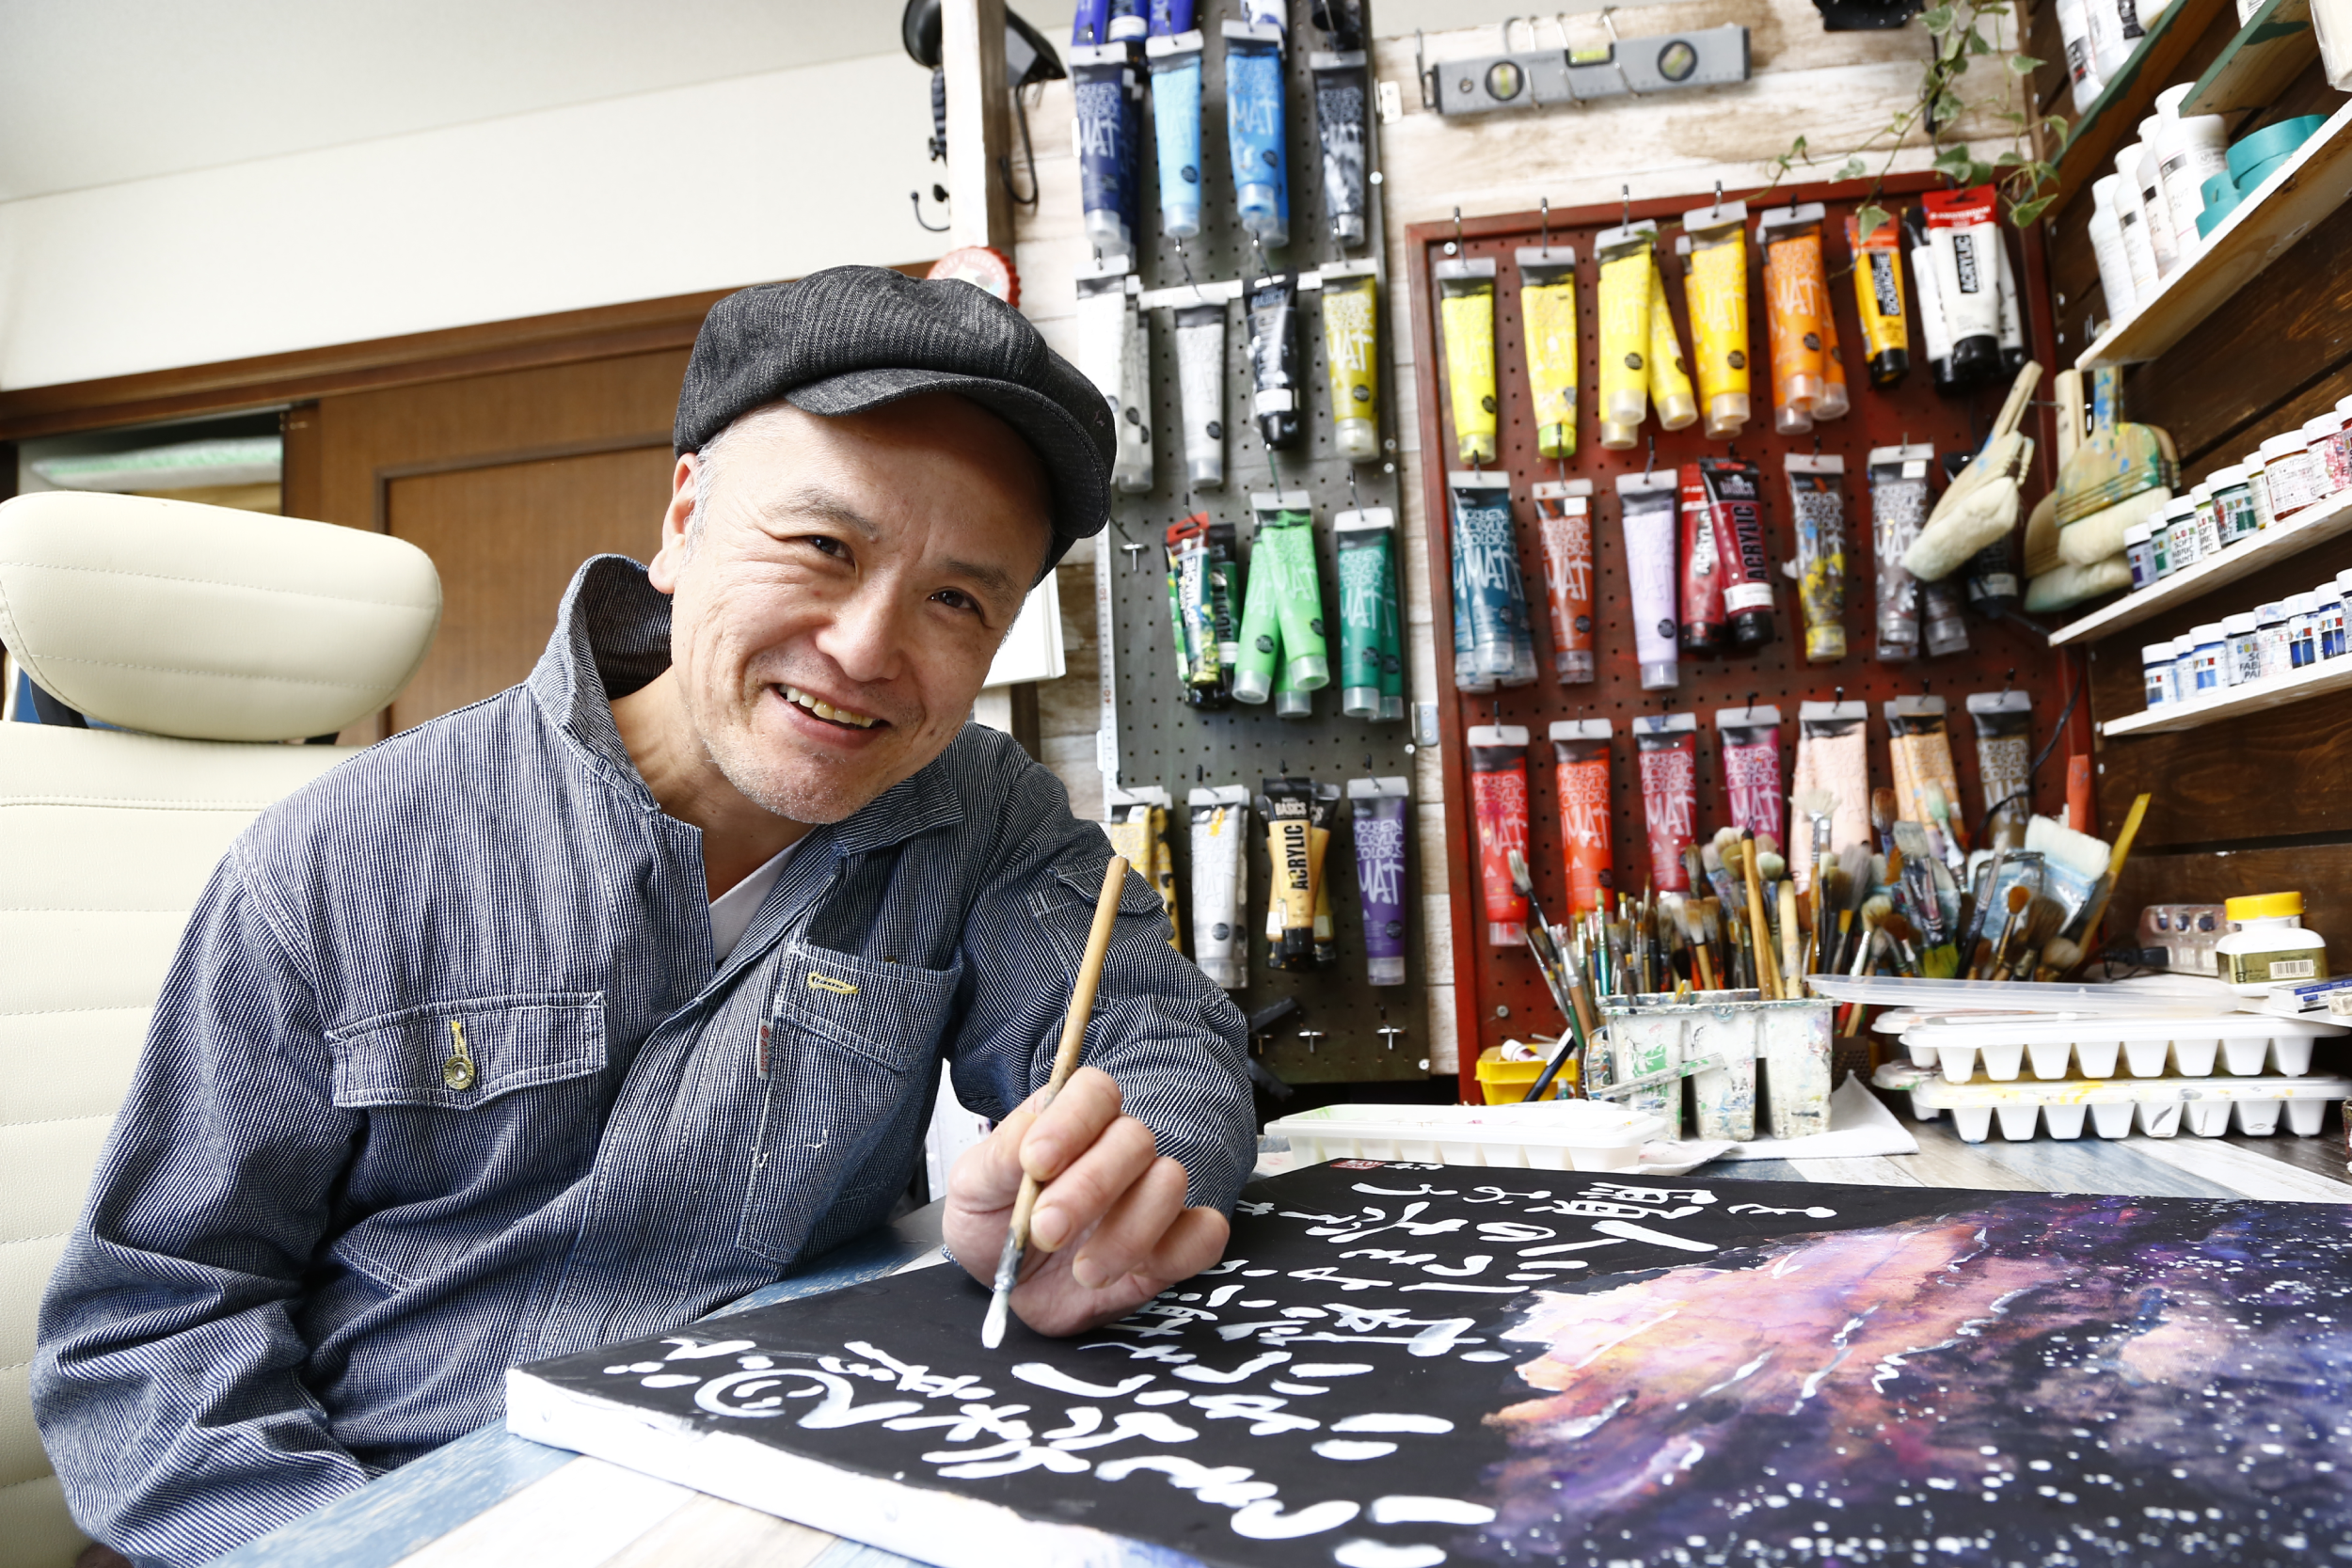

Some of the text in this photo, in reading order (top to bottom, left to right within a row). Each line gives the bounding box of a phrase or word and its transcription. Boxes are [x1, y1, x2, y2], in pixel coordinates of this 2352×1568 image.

[1955, 235, 1978, 293] ACRYLIC
[1734, 505, 1769, 580] ACRYLIC
[1275, 802, 1307, 816] BASICS
[1645, 791, 1697, 836] MAT
[1283, 824, 1309, 891] ACRYLIC
[1358, 858, 1406, 905] MAT
